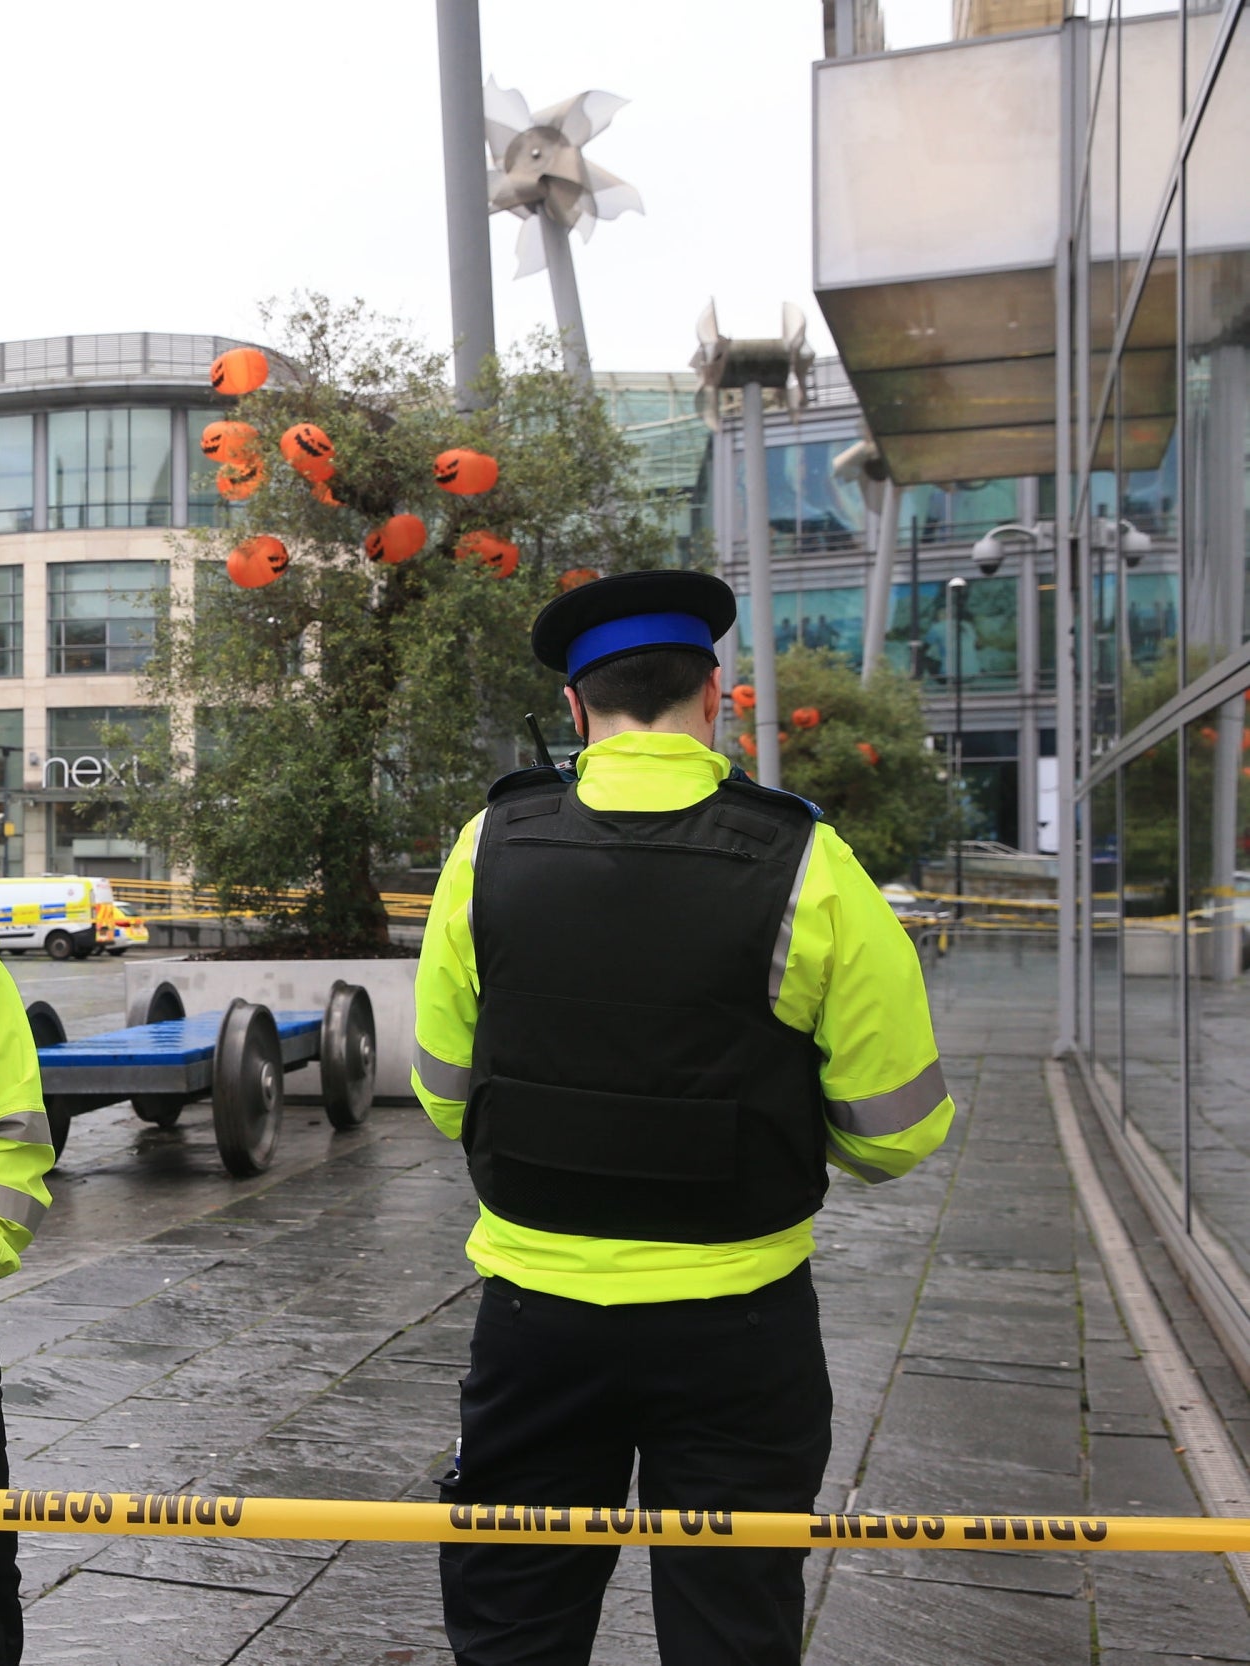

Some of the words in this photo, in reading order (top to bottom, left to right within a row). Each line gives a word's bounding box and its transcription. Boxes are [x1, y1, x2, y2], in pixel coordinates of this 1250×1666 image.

[42, 755, 152, 788] next
[3, 1490, 113, 1523] SCENE
[127, 1494, 245, 1527] CRIME
